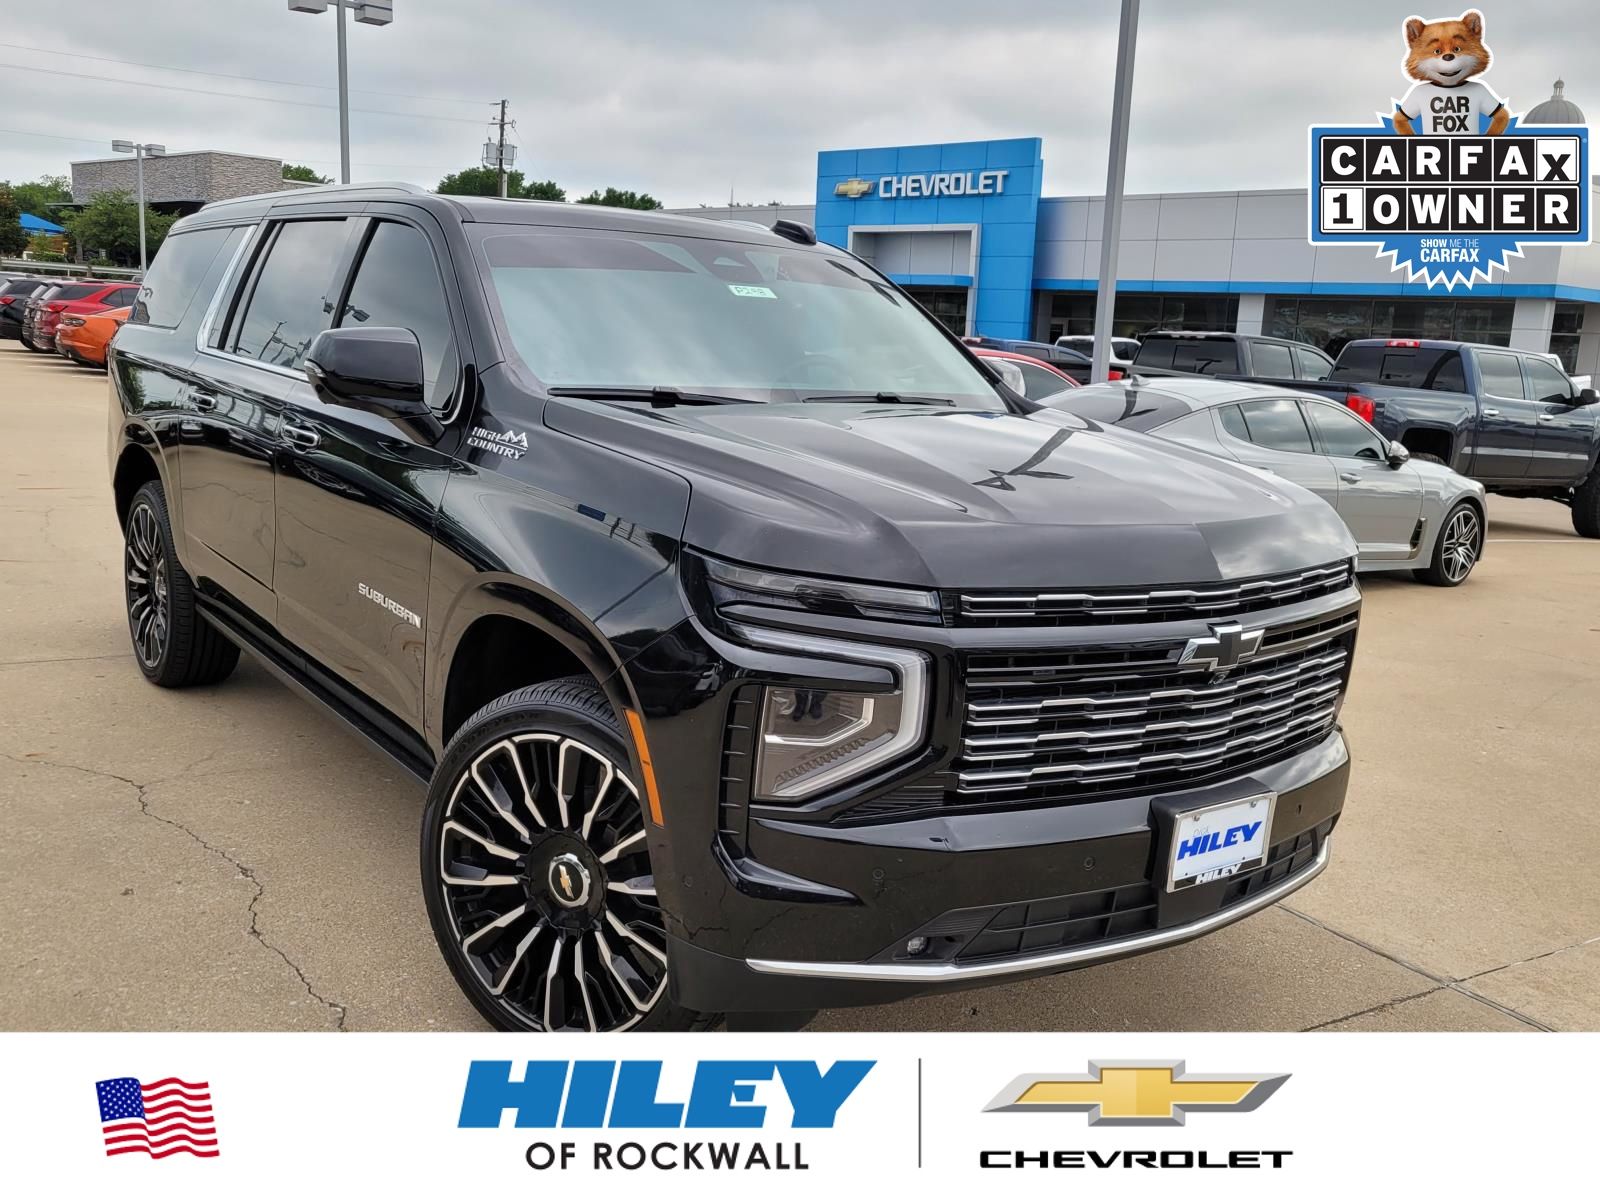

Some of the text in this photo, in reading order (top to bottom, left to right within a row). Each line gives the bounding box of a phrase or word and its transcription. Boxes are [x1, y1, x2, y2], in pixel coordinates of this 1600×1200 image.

[879, 171, 1008, 198] CHEVROLET
[472, 426, 501, 441] HIGH
[467, 437, 525, 459] COUNTRY
[358, 582, 421, 629] SUBURBAN
[1177, 821, 1262, 860] HILEY
[1195, 864, 1242, 884] HILEY
